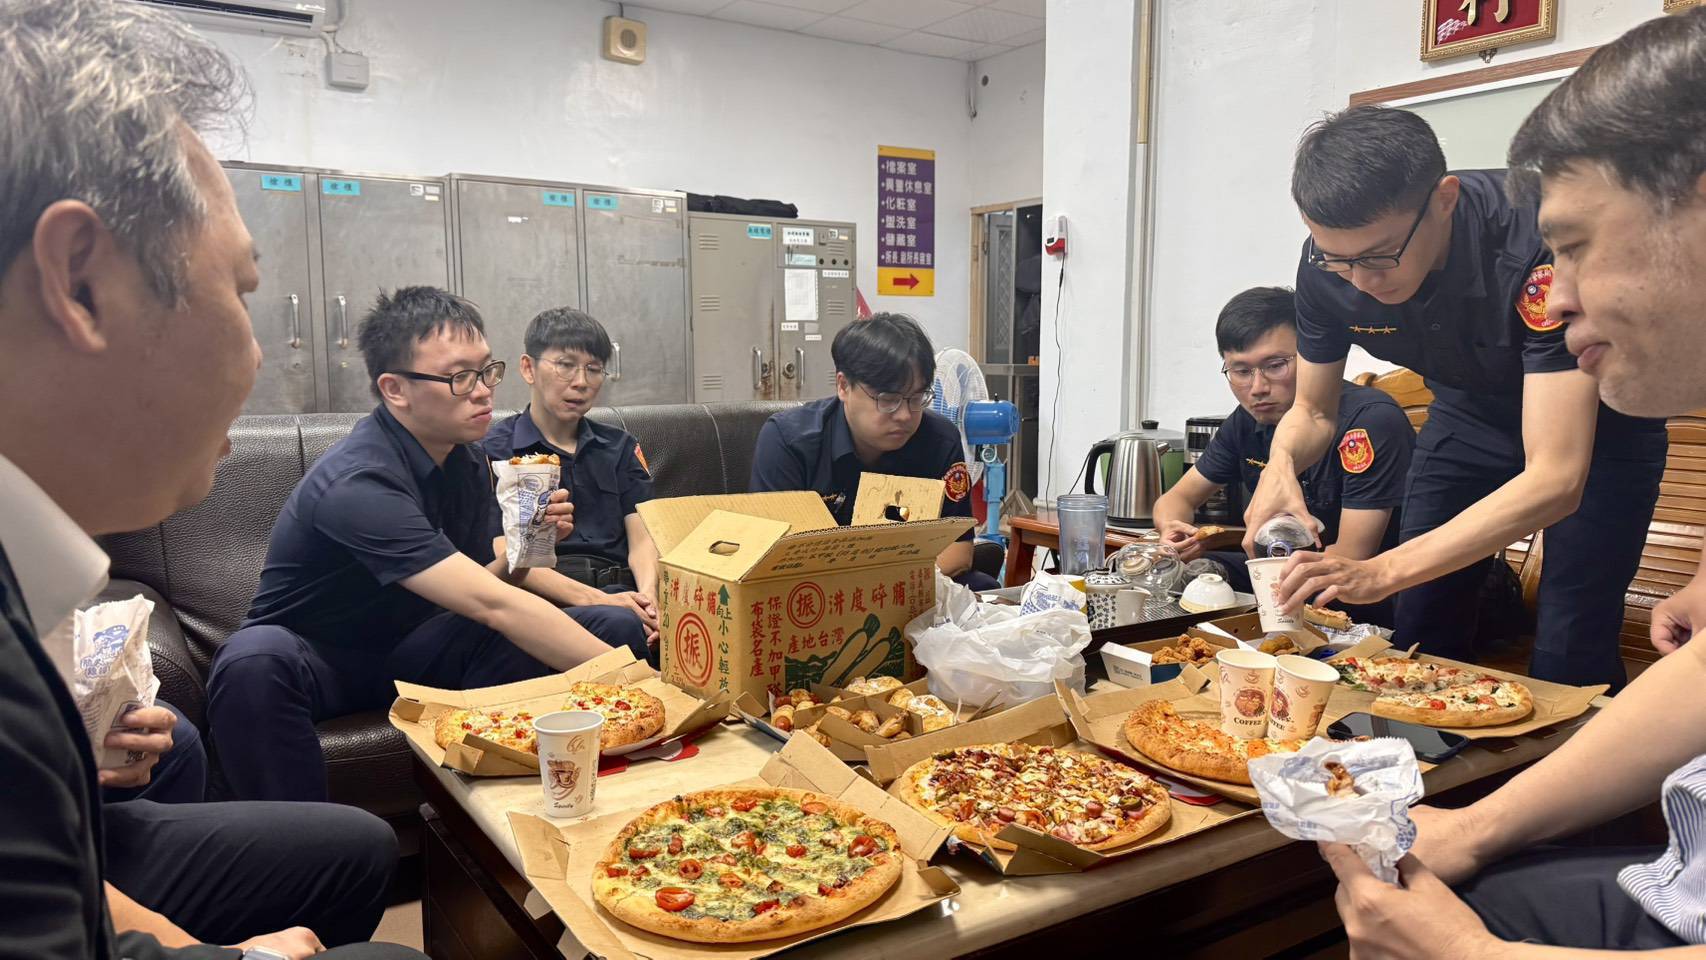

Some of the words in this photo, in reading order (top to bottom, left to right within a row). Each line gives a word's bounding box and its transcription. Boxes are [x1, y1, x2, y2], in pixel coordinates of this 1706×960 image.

[749, 601, 766, 677] 布袋名產
[787, 626, 845, 655] 產地台灣
